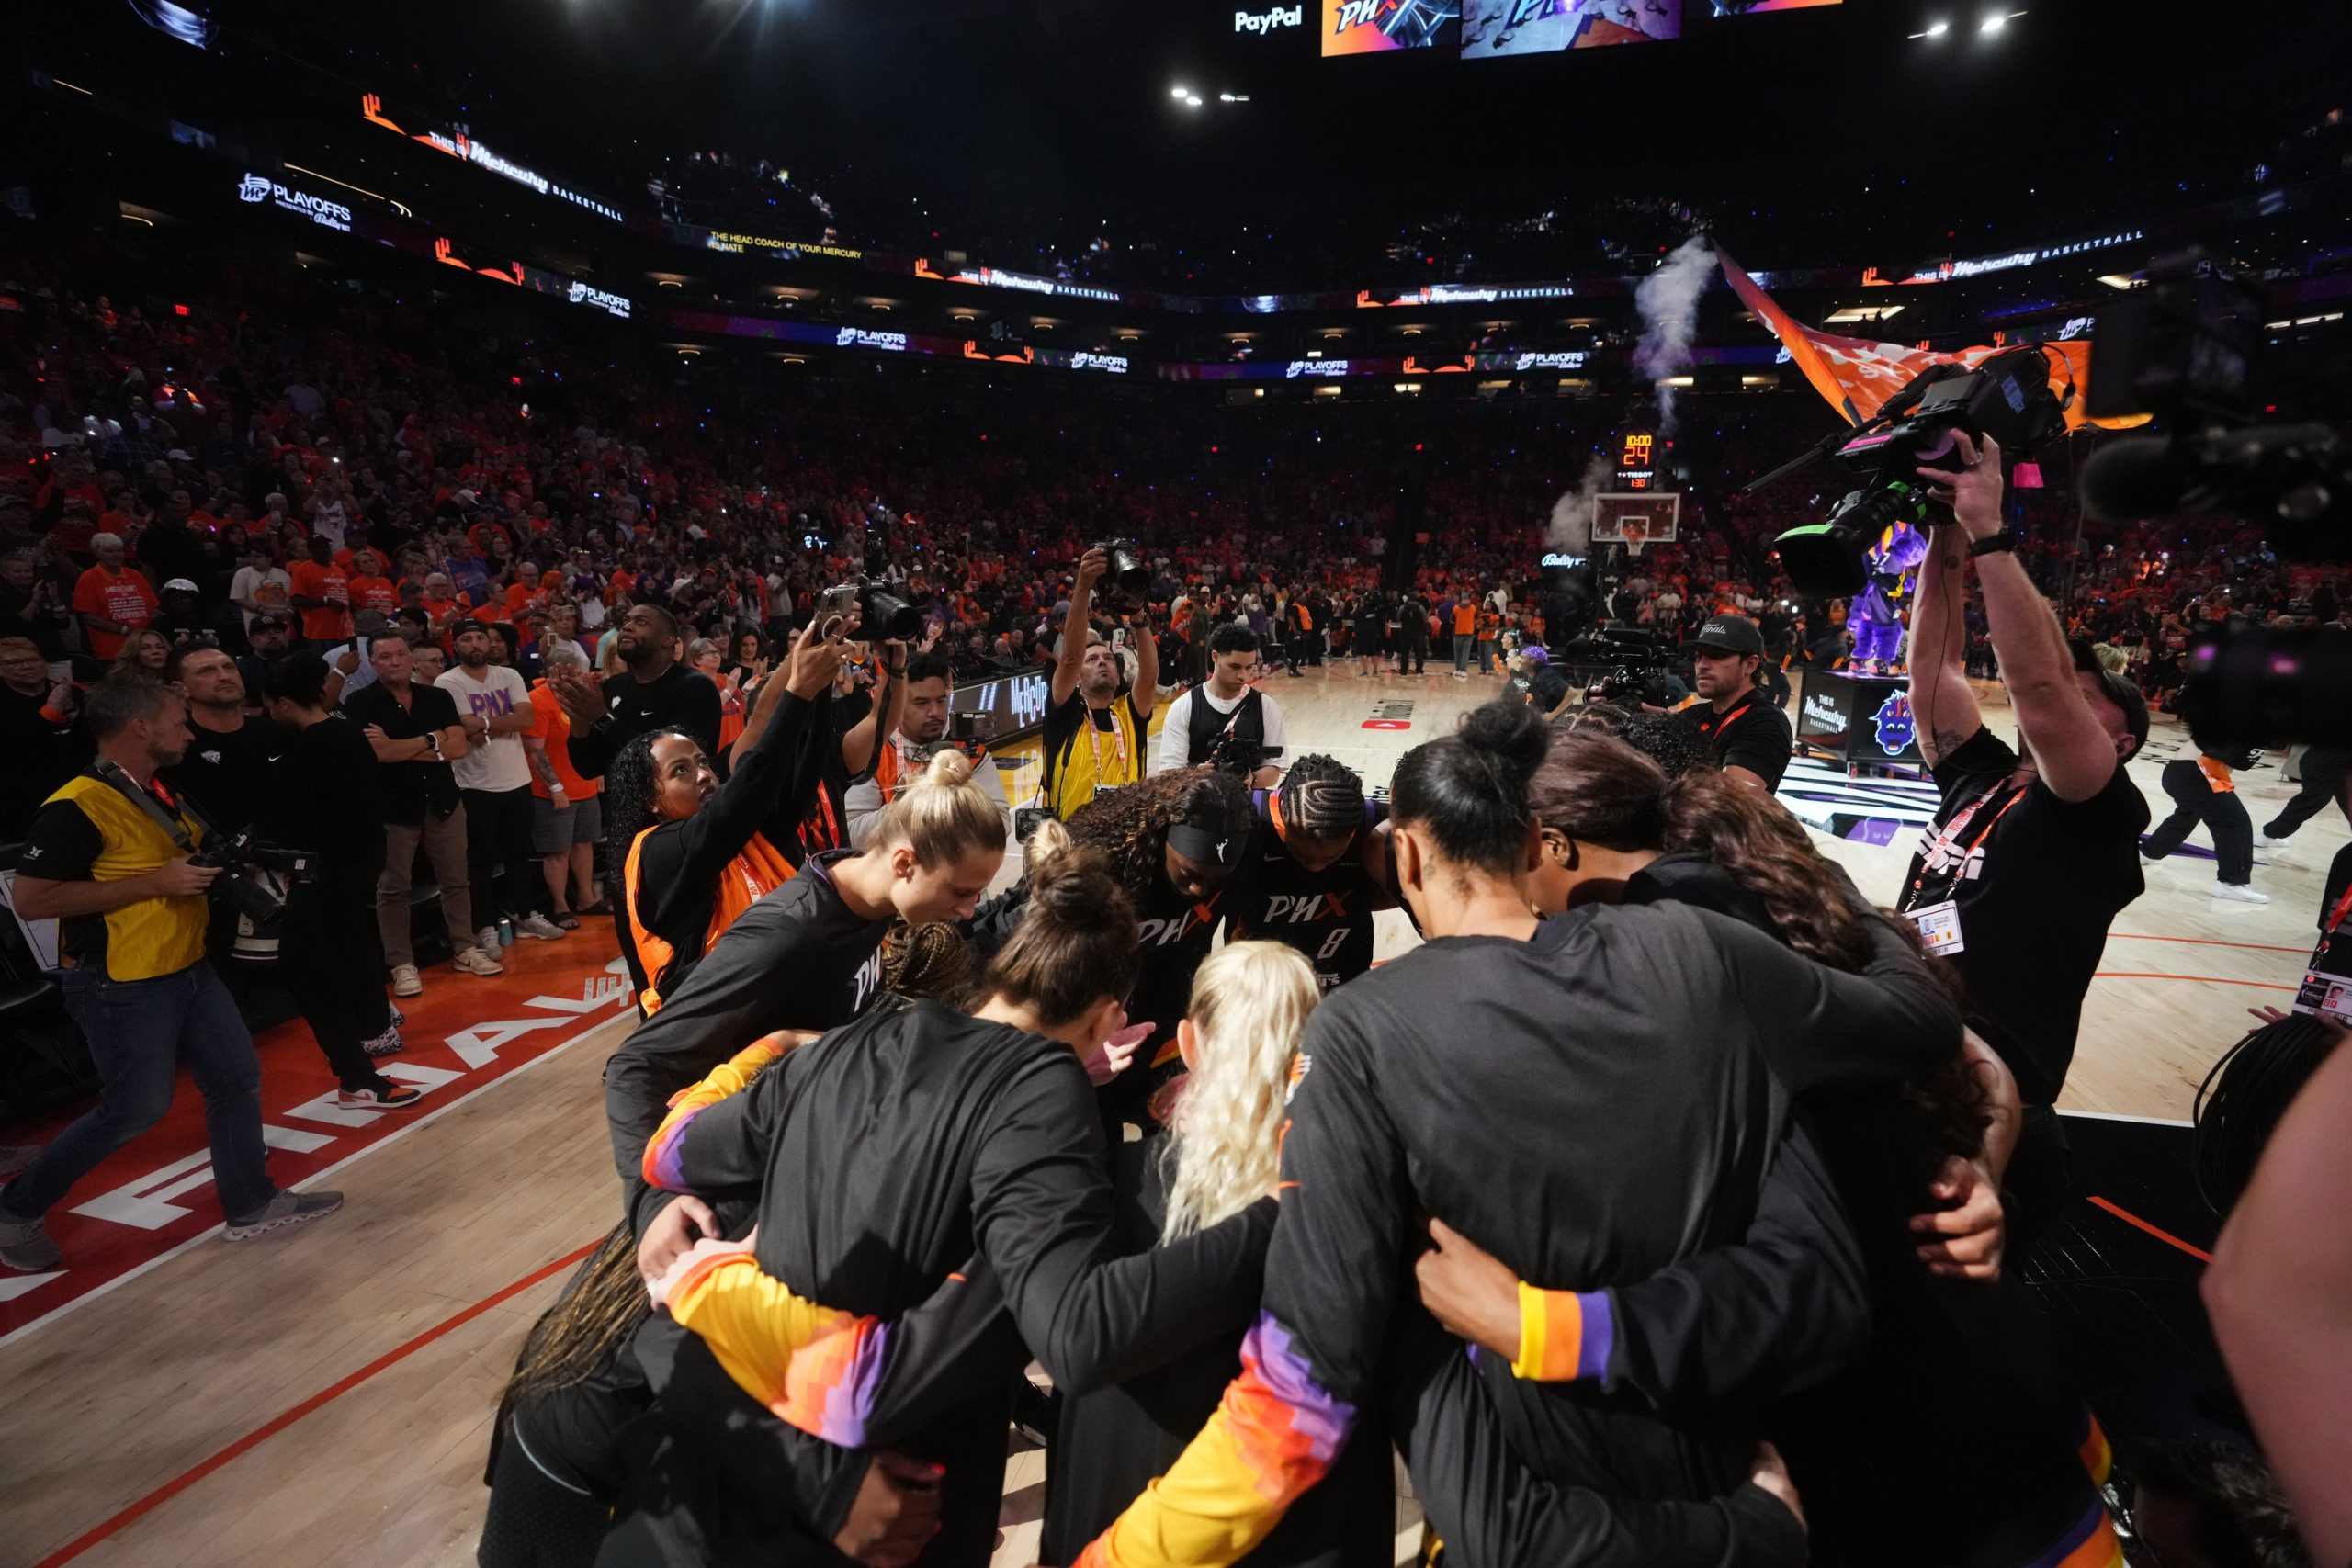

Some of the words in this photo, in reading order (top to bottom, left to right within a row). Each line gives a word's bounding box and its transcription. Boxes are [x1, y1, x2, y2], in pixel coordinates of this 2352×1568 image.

[1235, 5, 1302, 35] PayPal
[429, 131, 456, 152] THIS
[456, 143, 467, 156] IS
[469, 141, 548, 194] Mercury
[553, 185, 623, 222] BASKETBALL
[273, 184, 351, 221] PLAYOFFS
[711, 231, 729, 241] THE
[729, 235, 753, 245] HEAD
[754, 238, 785, 249] COACH
[786, 242, 797, 250] OF
[798, 243, 822, 254] YOUR
[822, 247, 862, 259] MERCURY
[711, 242, 720, 250] IS
[722, 243, 744, 253] NATE
[1914, 271, 1937, 281] THIS
[1939, 270, 1948, 280] IS
[1952, 252, 2037, 276] Mercury
[2042, 231, 2143, 259] BASKETBALL
[960, 271, 979, 282] THIS
[990, 269, 1055, 294] Mercury
[1057, 285, 1120, 301] BASKETBALL
[587, 287, 630, 310] PLAYOFFS
[1399, 294, 1418, 303] THIS
[1430, 288, 1498, 302] Mercury
[1500, 288, 1574, 299] BASKETBALL
[857, 330, 906, 344] PLAYOFFS
[1088, 354, 1128, 367] PLAYOFFS
[1305, 360, 1348, 370] PLAYOFFS
[1536, 352, 1584, 363] PLAYOFFS
[1626, 435, 1652, 446] 10:00
[1623, 446, 1649, 465] 24
[1631, 479, 1645, 488] 1:30
[1541, 553, 1575, 569] Bally
[1699, 624, 1726, 638] Finals
[1819, 694, 1829, 705] THIS
[1829, 697, 1835, 707] IS
[1804, 695, 1847, 732] Mercury
[1810, 718, 1838, 734] BASKETBALL
[1263, 889, 1353, 923] PHX
[1138, 890, 1223, 946] PHX
[1317, 928, 1351, 960] 8
